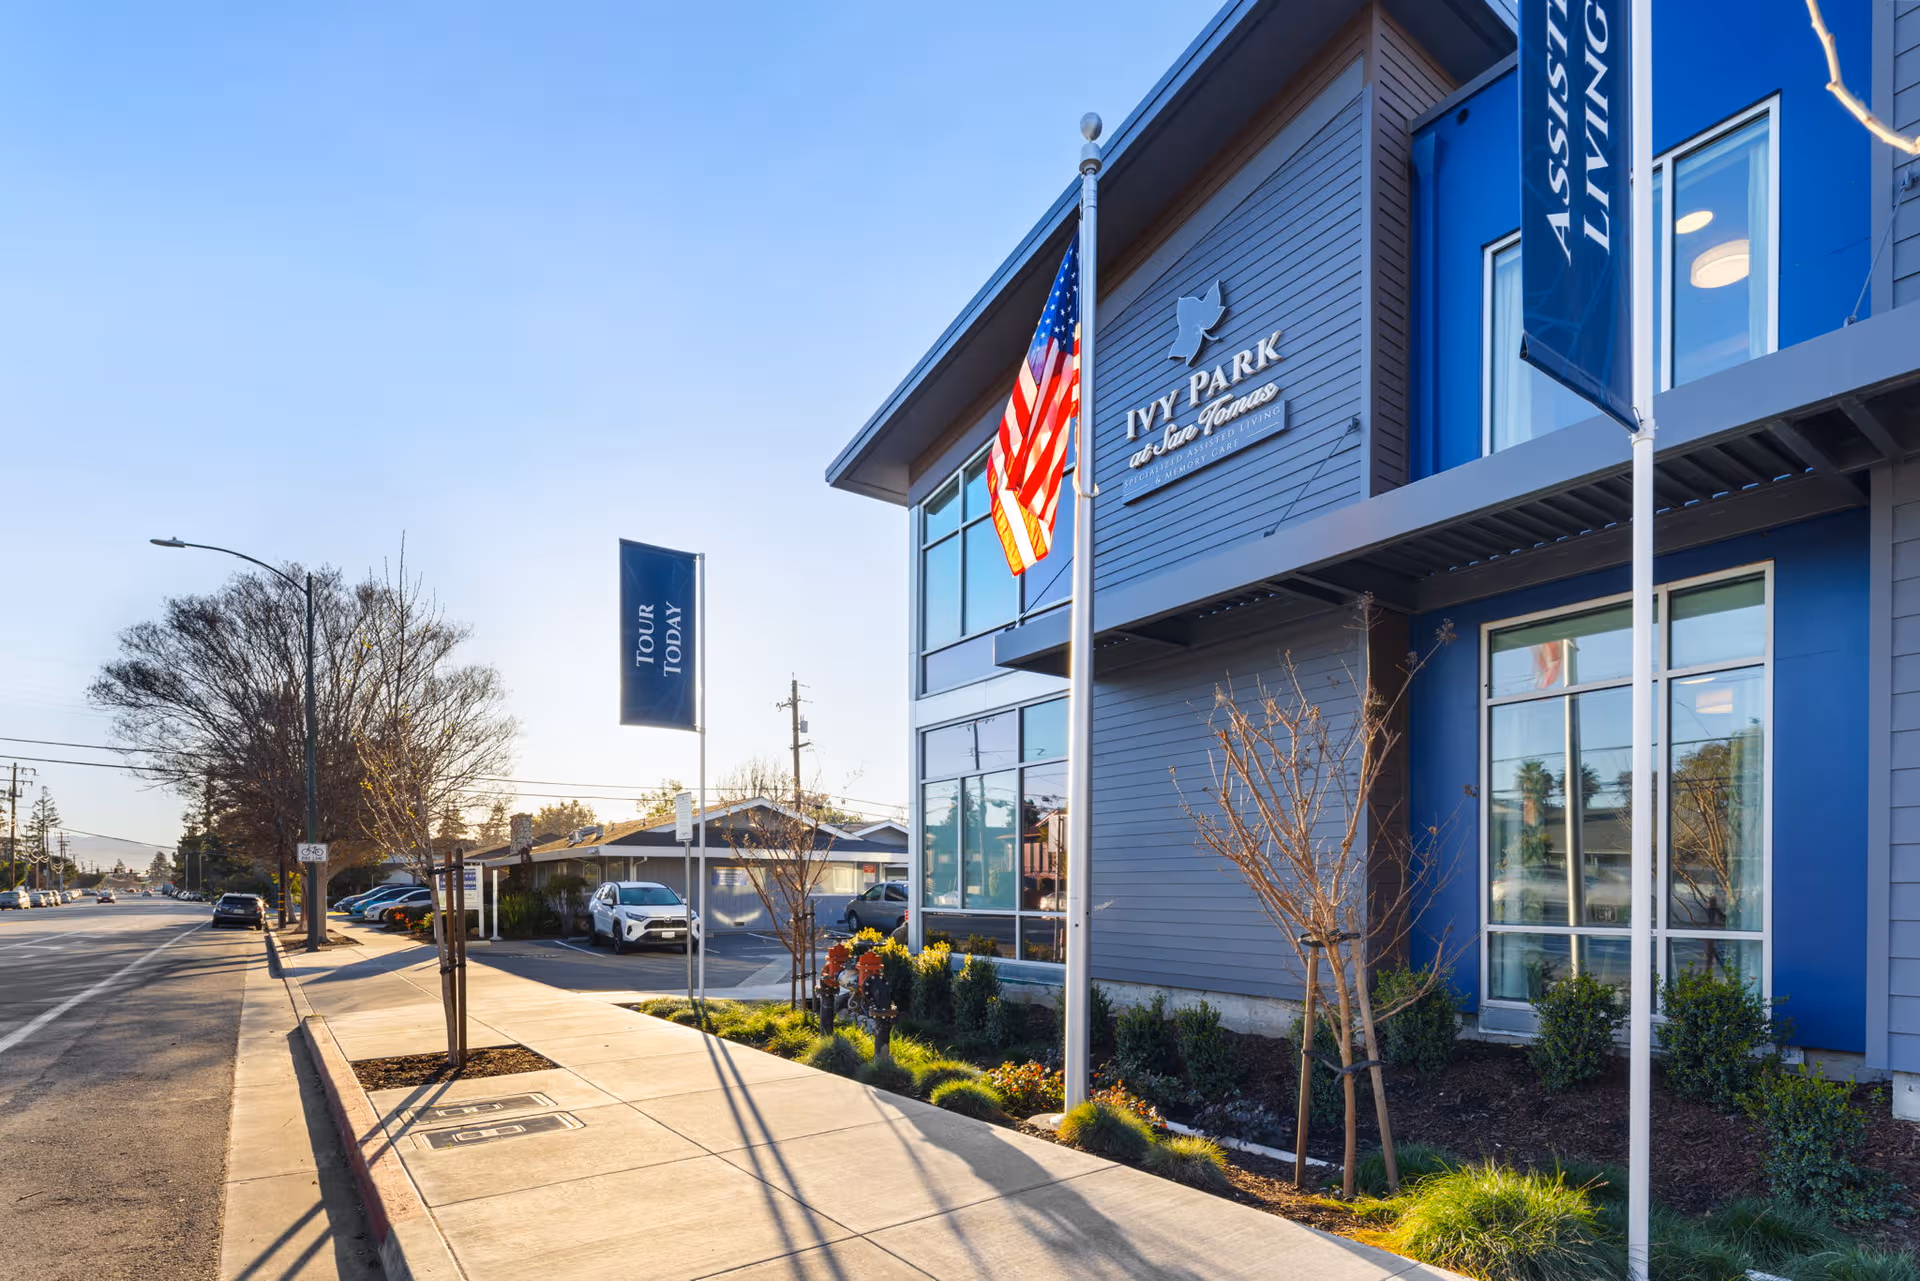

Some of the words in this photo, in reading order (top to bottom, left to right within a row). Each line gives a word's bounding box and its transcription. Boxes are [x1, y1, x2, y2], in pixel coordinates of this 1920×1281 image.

[1584, 0, 1610, 256] LIVING
[1126, 388, 1179, 441] IVY
[1188, 329, 1284, 408] PARK
[1129, 443, 1153, 469] at
[1153, 423, 1199, 456] San
[1198, 382, 1281, 436] Tomas
[1123, 454, 1183, 489] SPECIALIZED
[1187, 429, 1235, 458] ASSISTED
[1240, 406, 1280, 432] LIVING
[1165, 454, 1207, 479] MEMORY
[1211, 439, 1239, 458] CARE
[636, 604, 655, 667] TOUR
[664, 600, 682, 677] TODAY
